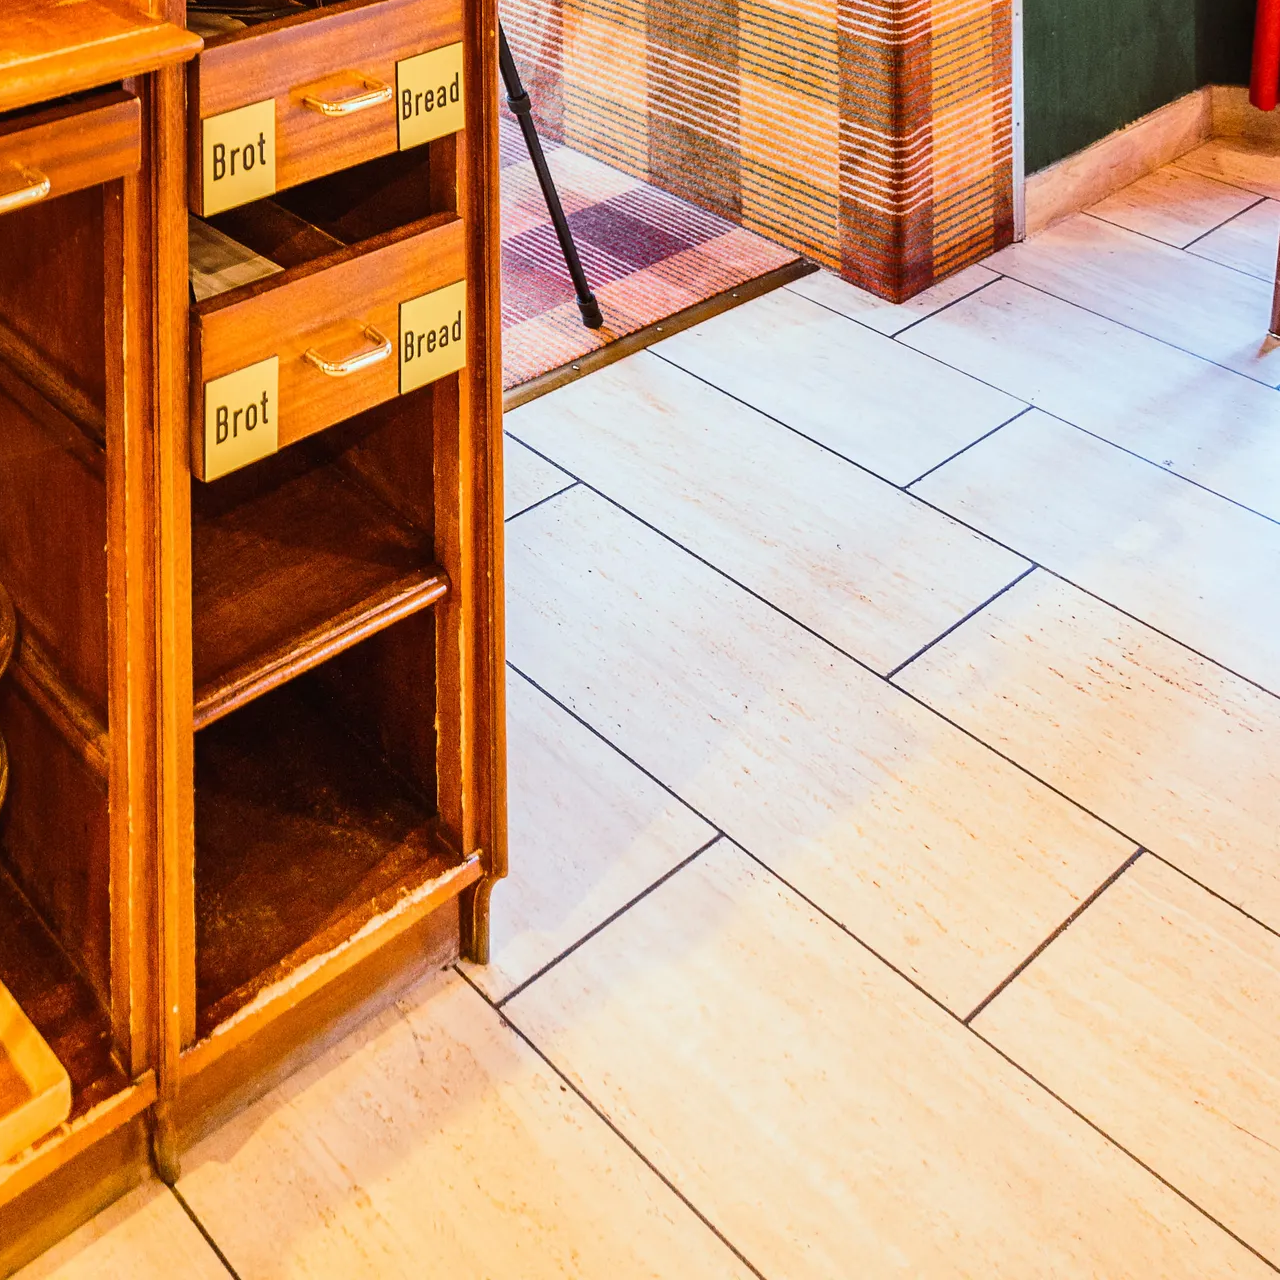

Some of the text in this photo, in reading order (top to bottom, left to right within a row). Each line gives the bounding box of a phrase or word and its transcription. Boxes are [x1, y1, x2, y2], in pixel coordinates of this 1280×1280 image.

[402, 72, 460, 120] Bread
[212, 133, 267, 180] Brot
[405, 311, 462, 363] Bread
[216, 391, 269, 445] Brot
